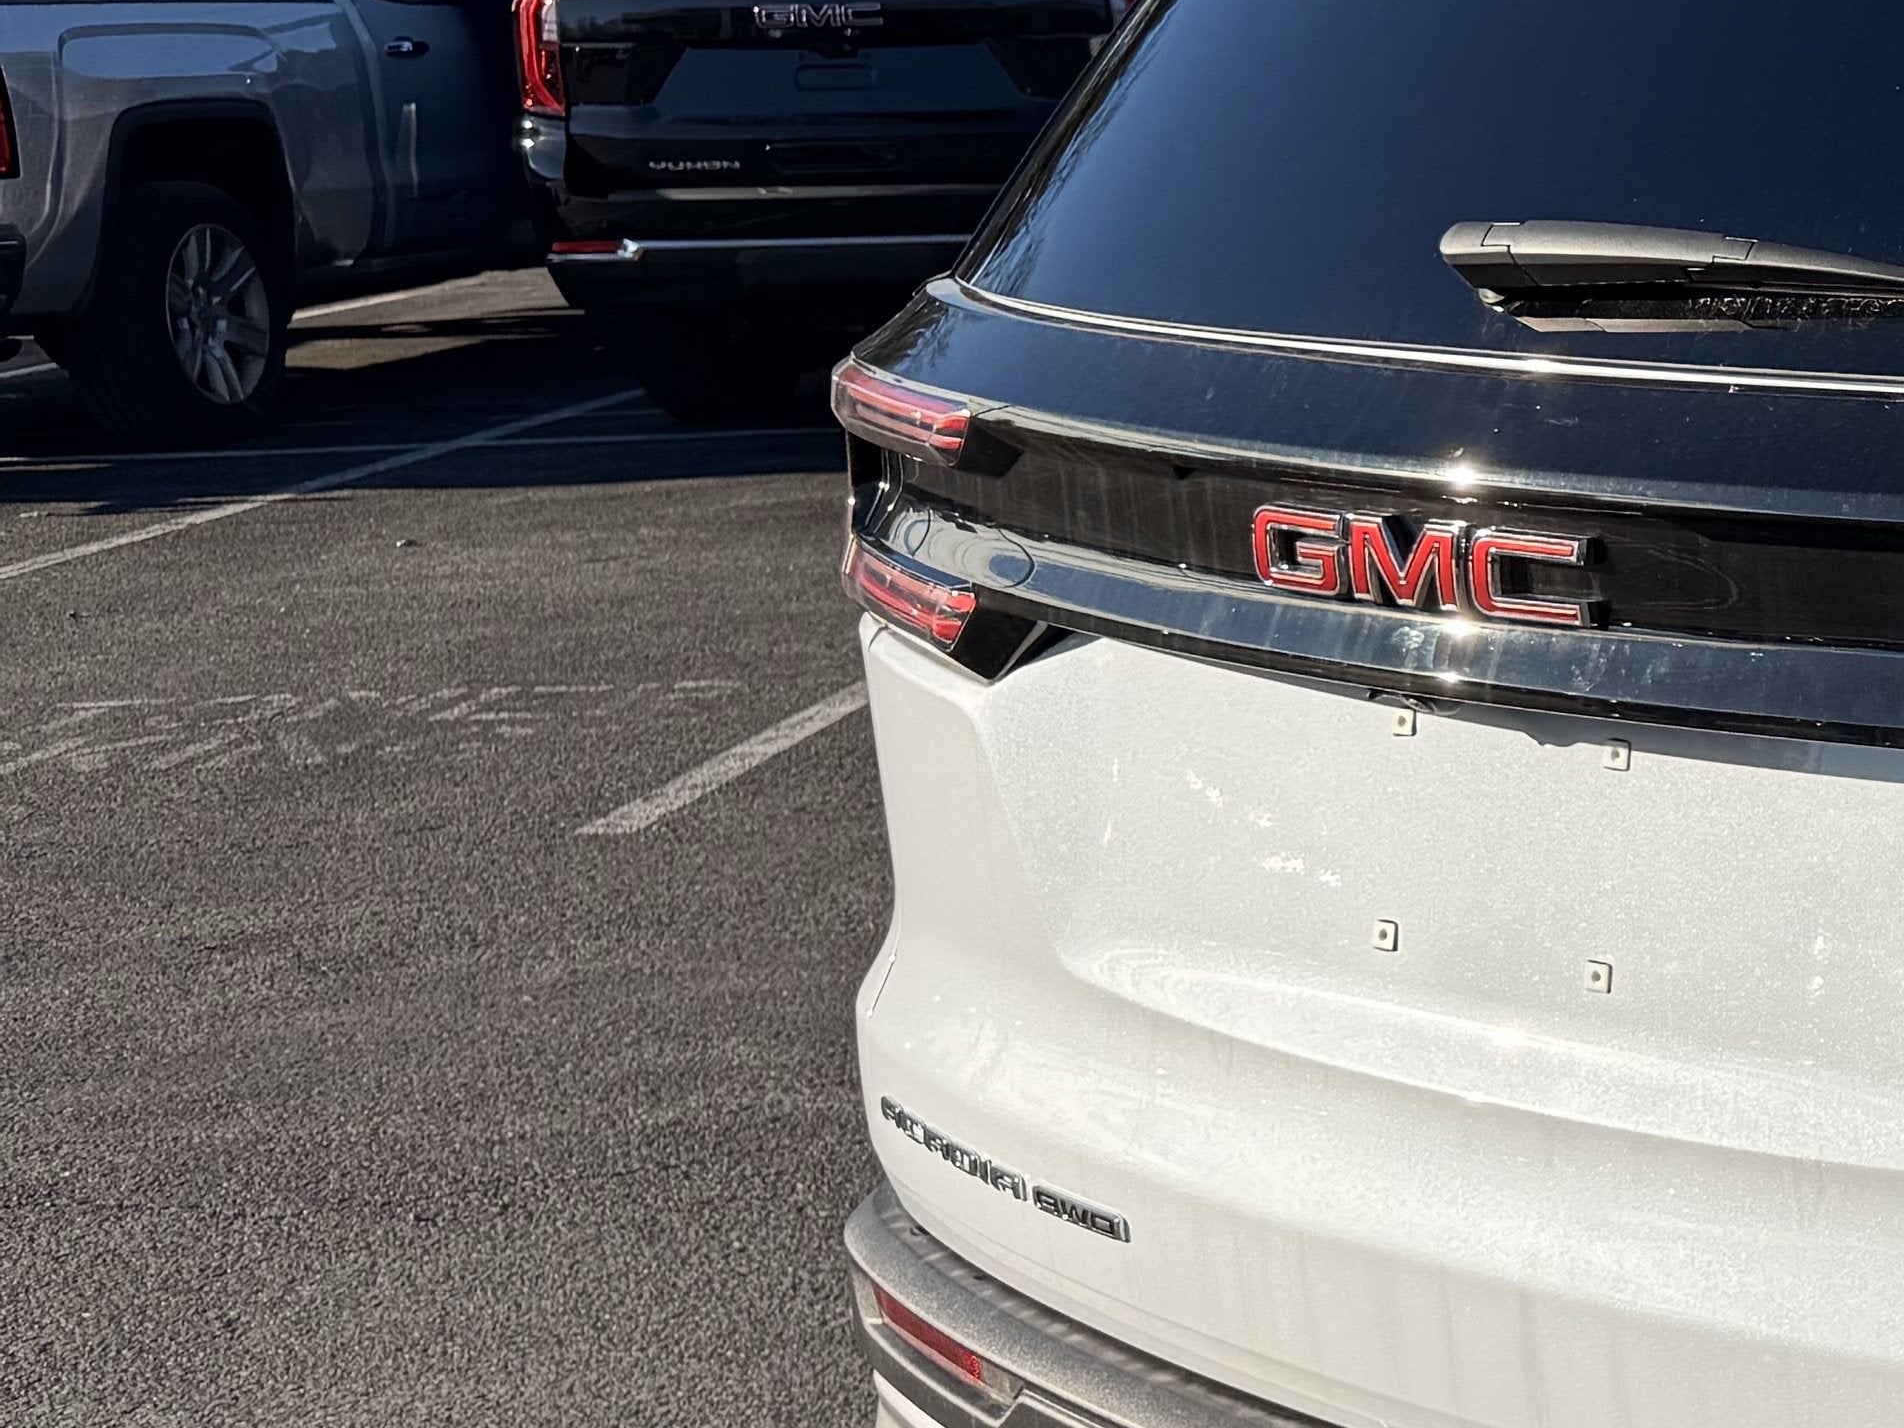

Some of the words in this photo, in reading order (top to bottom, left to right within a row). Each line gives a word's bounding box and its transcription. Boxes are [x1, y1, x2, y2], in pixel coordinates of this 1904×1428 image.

[753, 3, 884, 29] GMC
[1251, 503, 1602, 628] GMC
[880, 1095, 1029, 1202] ACADIA
[1034, 1184, 1128, 1241] AWD
